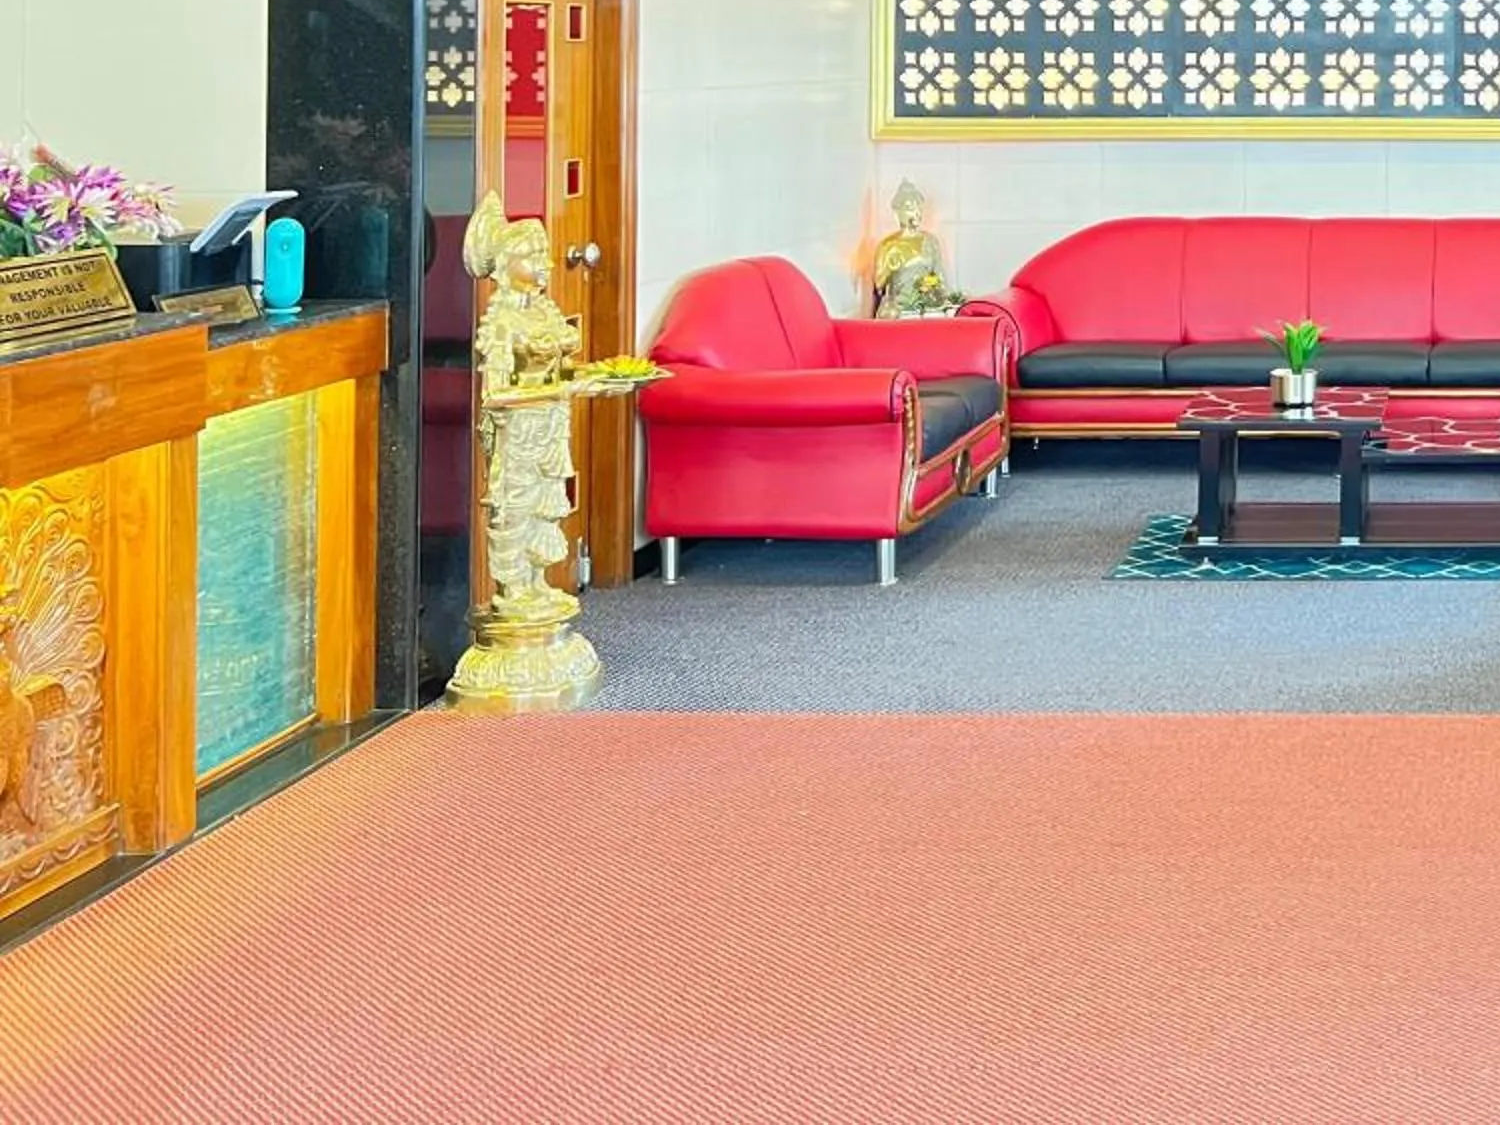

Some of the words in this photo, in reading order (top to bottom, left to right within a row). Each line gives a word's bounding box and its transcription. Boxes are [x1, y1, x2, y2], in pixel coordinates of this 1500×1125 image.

[74, 261, 97, 273] NOT
[9, 281, 87, 303] RESPONSIBLE
[24, 306, 56, 321] YOUR
